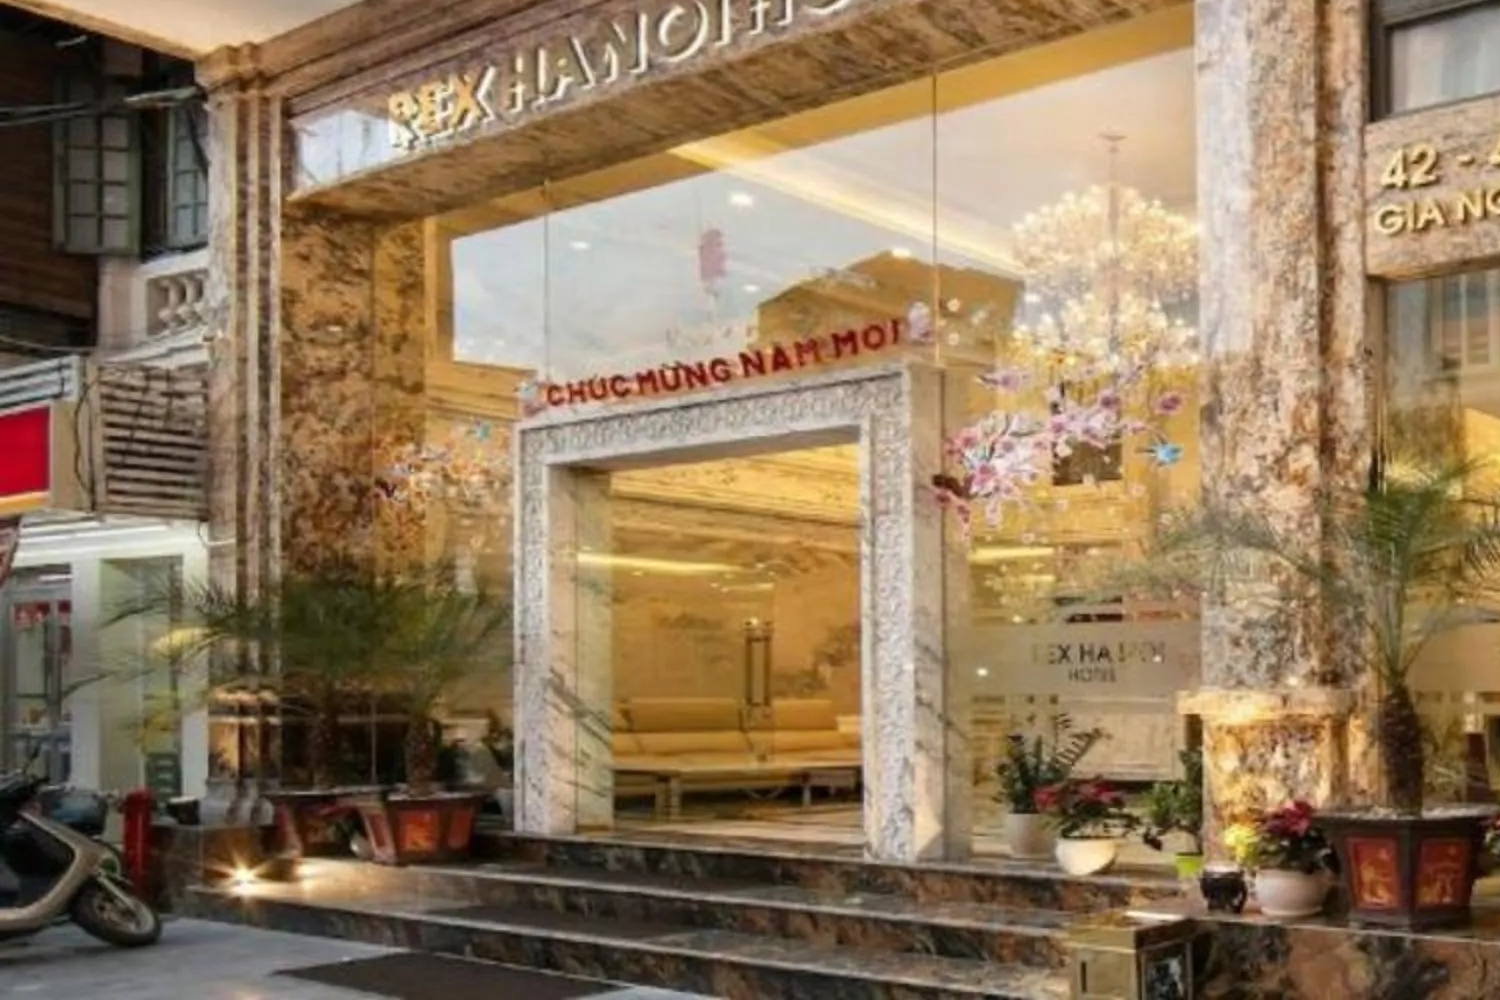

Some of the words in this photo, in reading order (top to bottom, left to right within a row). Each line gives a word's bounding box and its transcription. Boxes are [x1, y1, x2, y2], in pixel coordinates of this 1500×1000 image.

[387, 66, 498, 147] REX
[1380, 142, 1440, 189] 42
[1374, 197, 1447, 235] GIA
